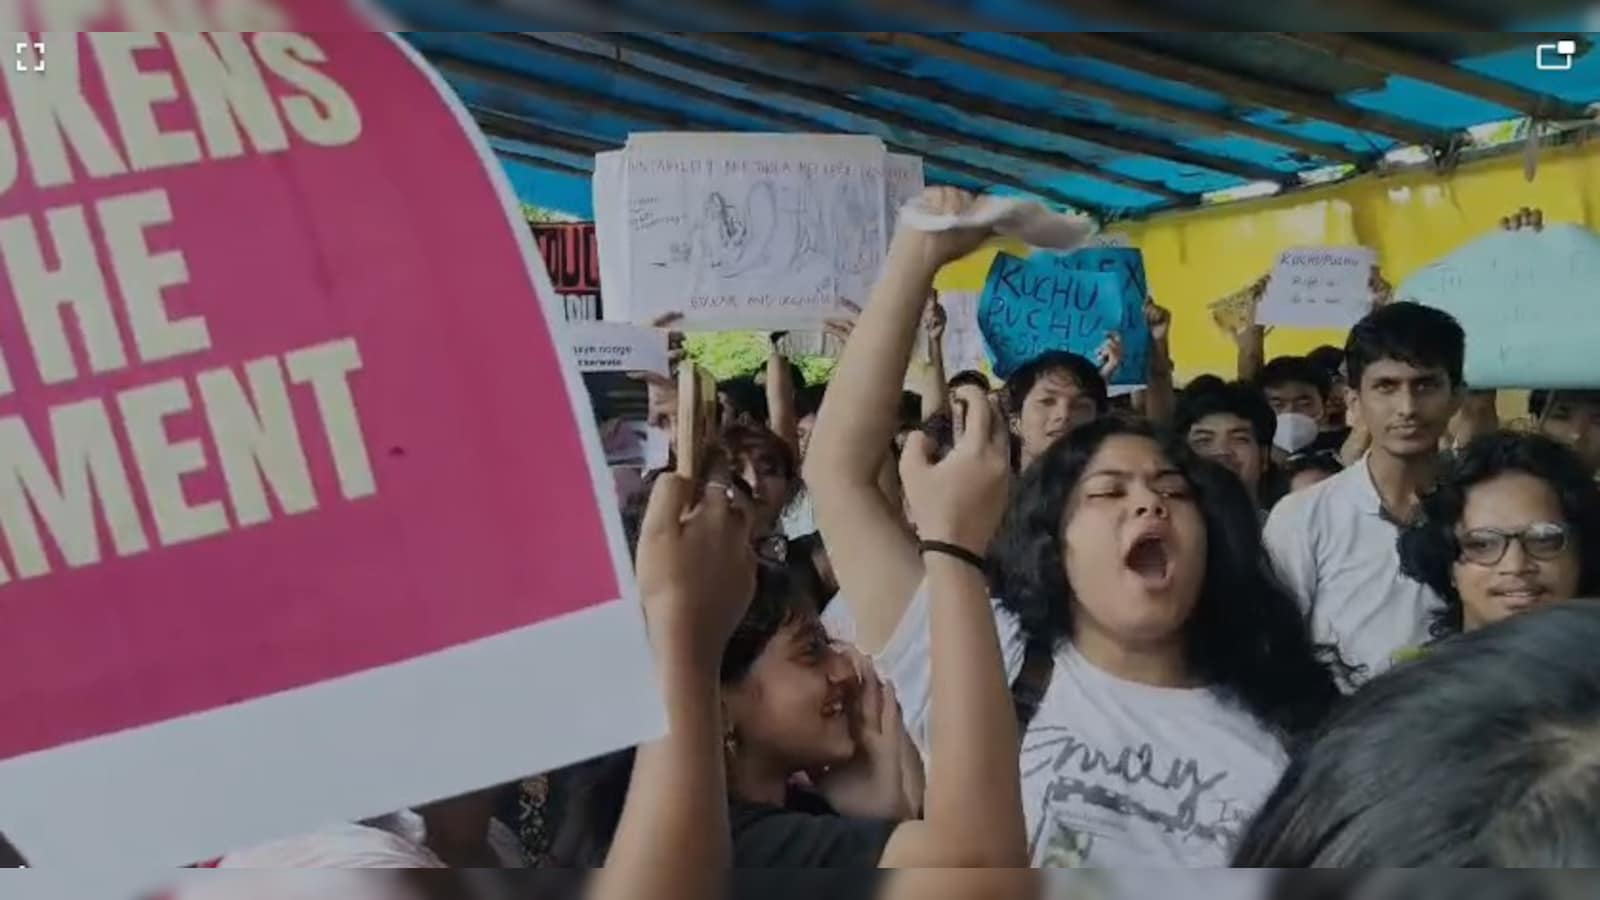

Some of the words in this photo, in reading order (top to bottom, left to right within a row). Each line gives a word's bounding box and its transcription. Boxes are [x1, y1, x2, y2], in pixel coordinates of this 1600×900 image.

[0, 32, 362, 194] KENS
[986, 297, 1103, 340] PUCHU
[993, 254, 1099, 311] KUCHU
[0, 338, 377, 586] MENT
